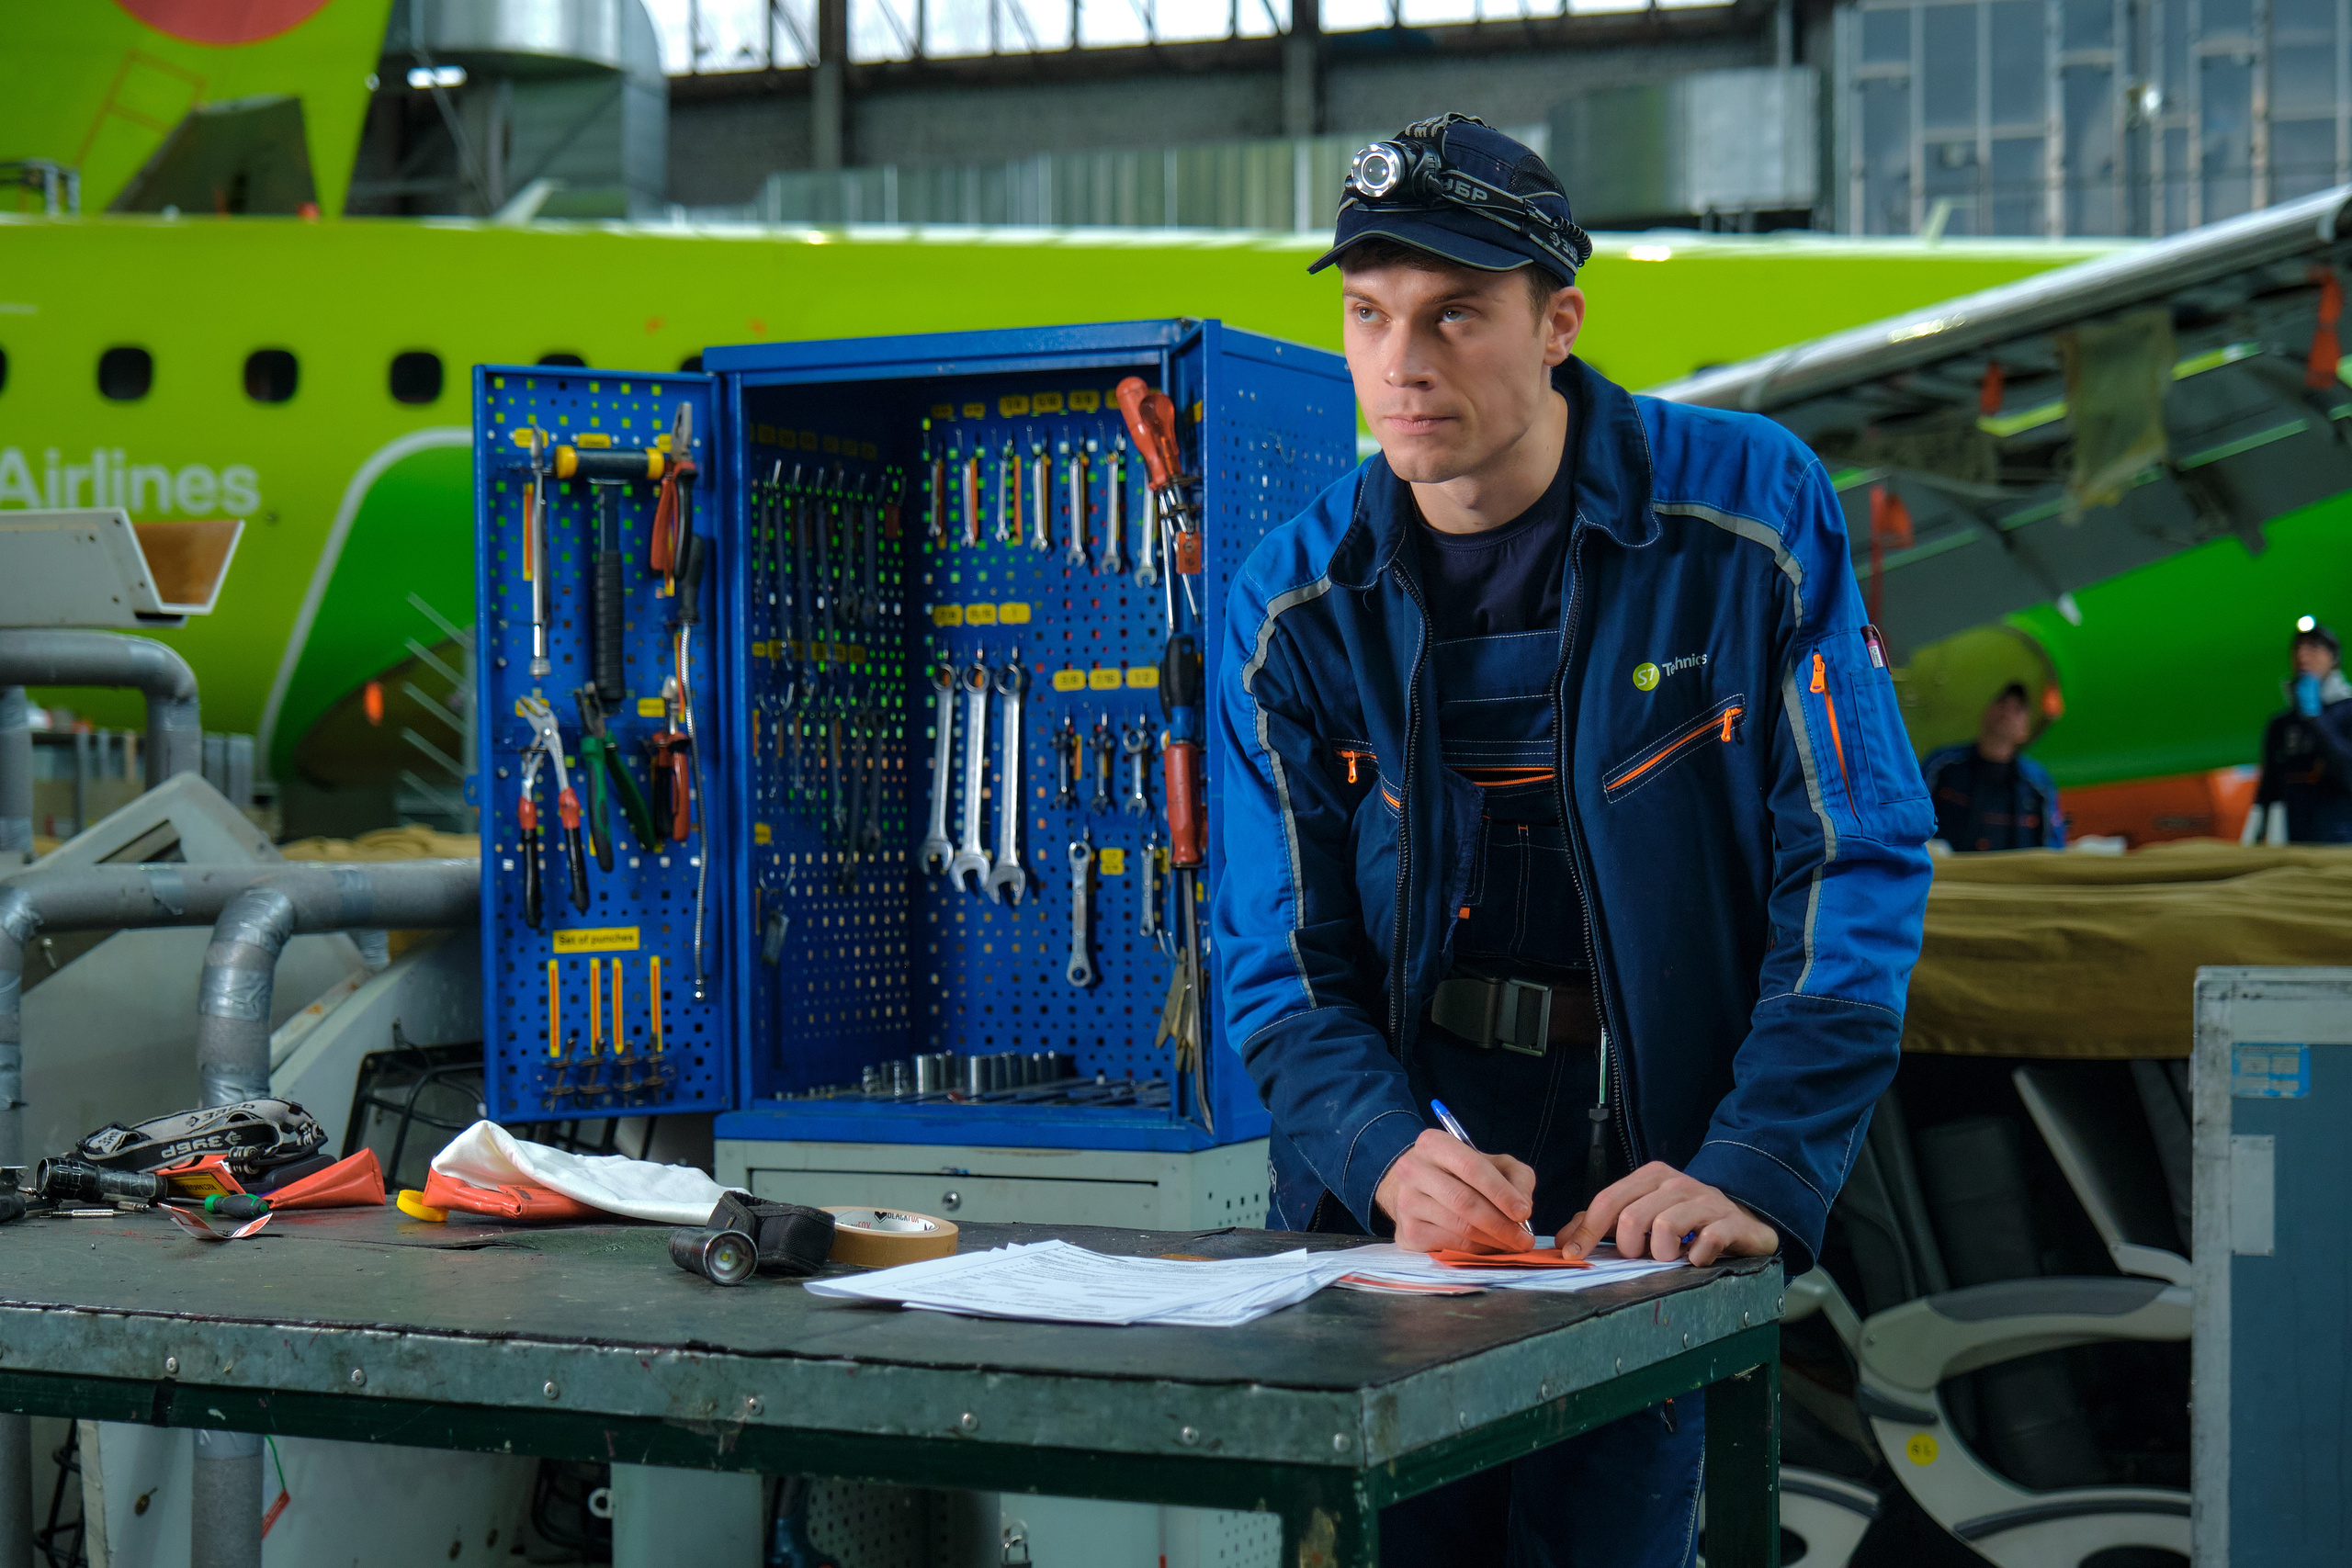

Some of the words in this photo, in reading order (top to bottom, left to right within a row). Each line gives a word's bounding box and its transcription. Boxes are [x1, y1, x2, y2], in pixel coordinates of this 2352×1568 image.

[1441, 178, 1488, 201] УБР
[1561, 238, 1578, 263] ЗУБ
[0, 446, 262, 516] Airlines
[1637, 666, 1656, 687] S7
[578, 934, 589, 944] of
